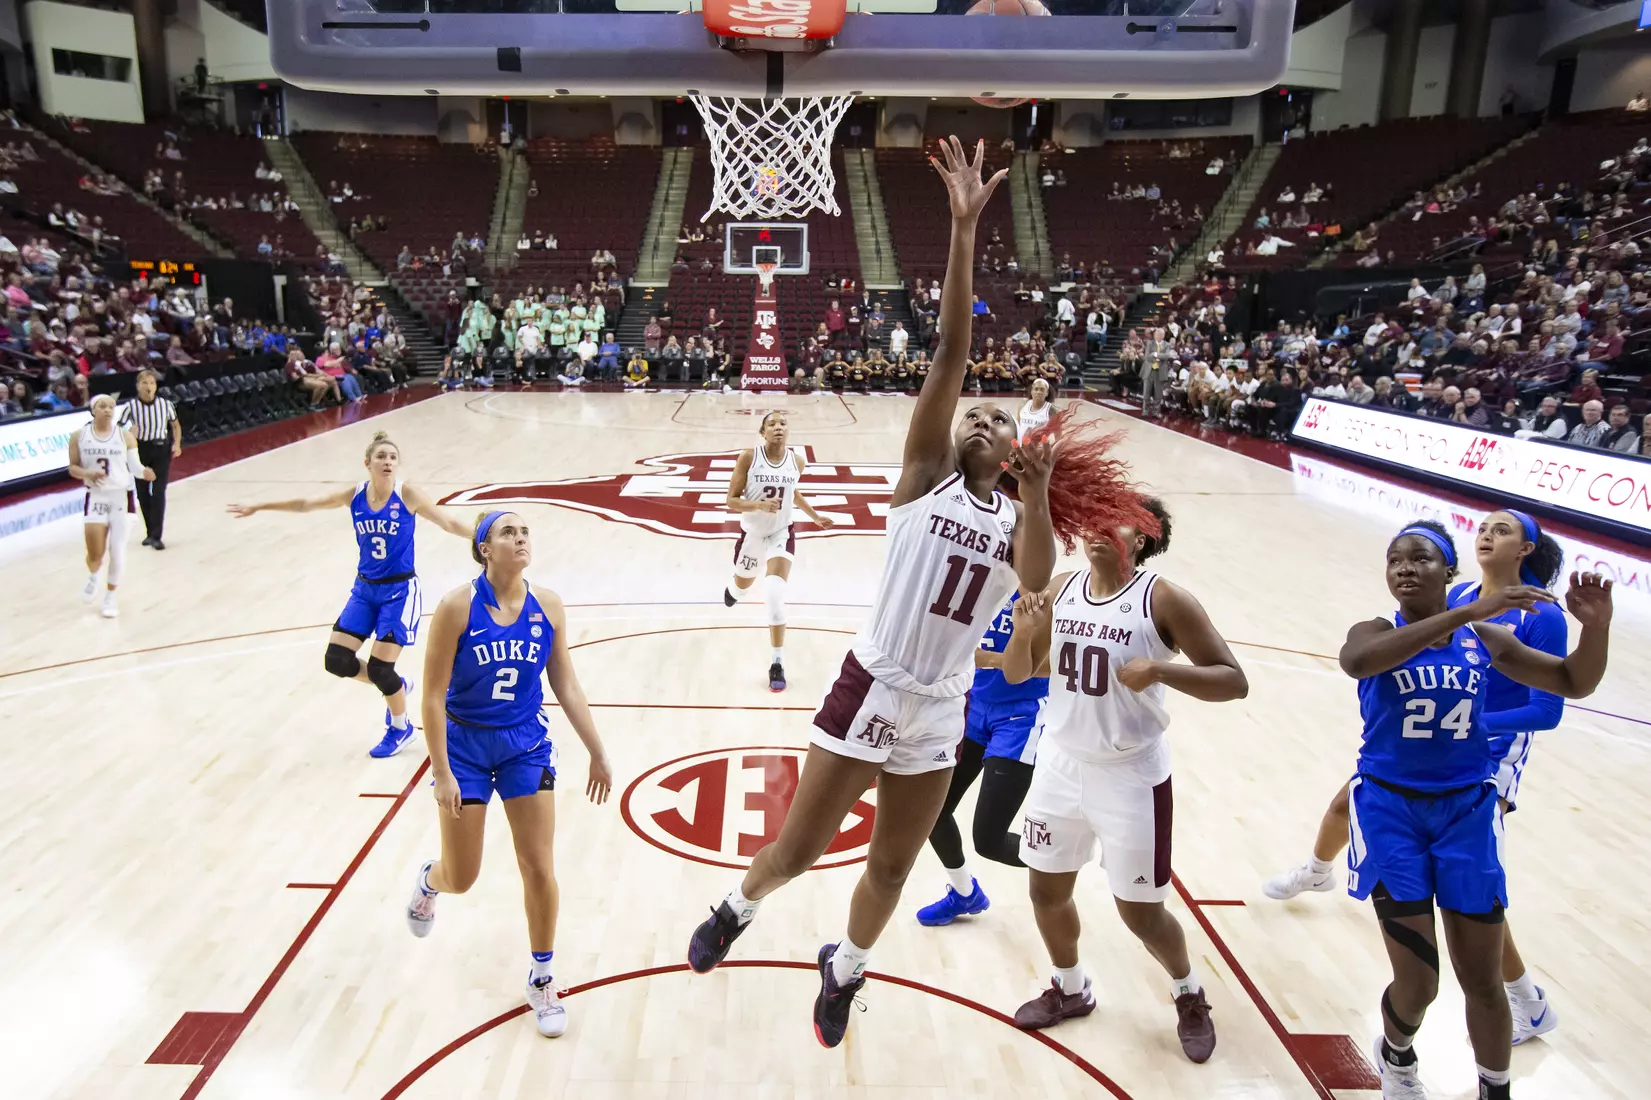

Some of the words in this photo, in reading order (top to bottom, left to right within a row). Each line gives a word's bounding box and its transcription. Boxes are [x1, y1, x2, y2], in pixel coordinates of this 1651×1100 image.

[749, 356, 781, 364] WELLS
[754, 474, 780, 483] TEXAS
[781, 476, 796, 485] A&M
[1459, 436, 1497, 470] ABC
[1524, 459, 1586, 495] PEST
[356, 519, 400, 536] DUKE
[929, 514, 991, 554] TEXAS
[371, 536, 387, 560] 3
[929, 554, 991, 626] 11
[1055, 618, 1096, 638] TEXAS
[1098, 624, 1132, 646] A&M
[472, 639, 541, 666] DUKE
[492, 667, 519, 701] 2
[1058, 641, 1109, 697] 40
[1392, 664, 1480, 695] DUKE
[1402, 698, 1473, 739] 24
